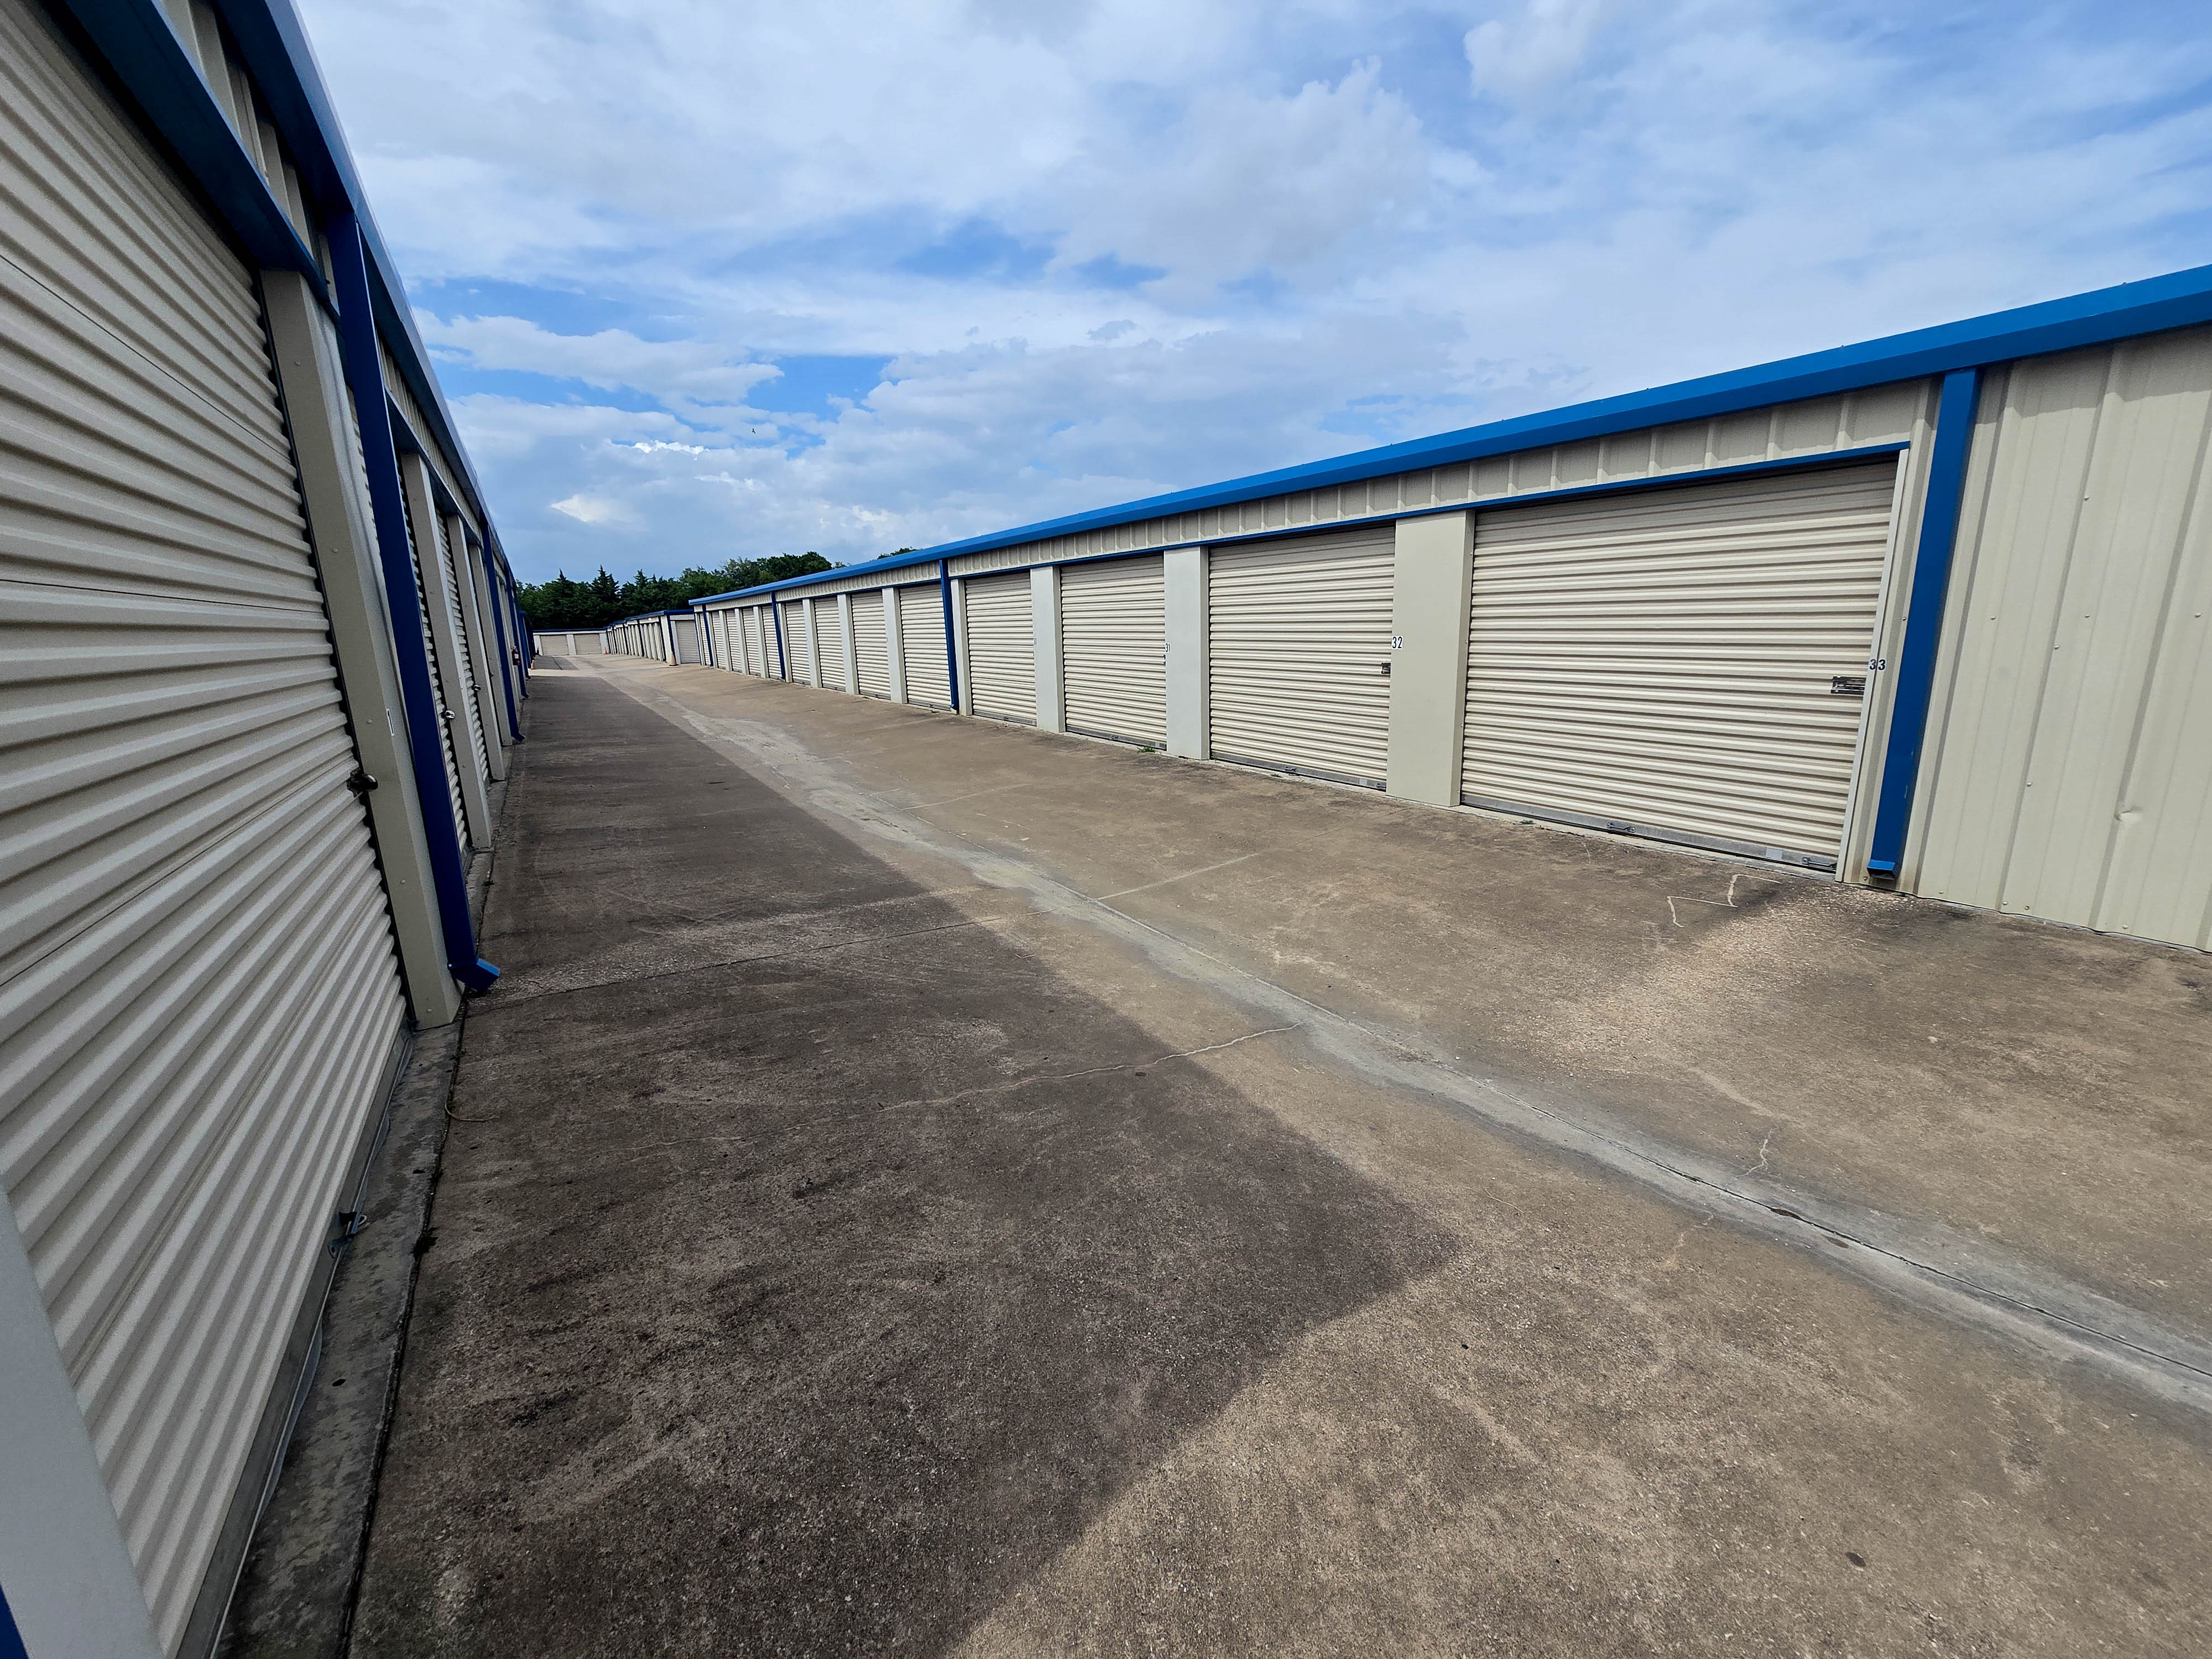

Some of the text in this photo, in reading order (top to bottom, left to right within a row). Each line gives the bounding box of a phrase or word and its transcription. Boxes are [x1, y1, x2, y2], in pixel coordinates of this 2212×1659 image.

[1165, 643, 1170, 652] 31
[1392, 637, 1402, 648] 32
[1870, 659, 1886, 670] 33
